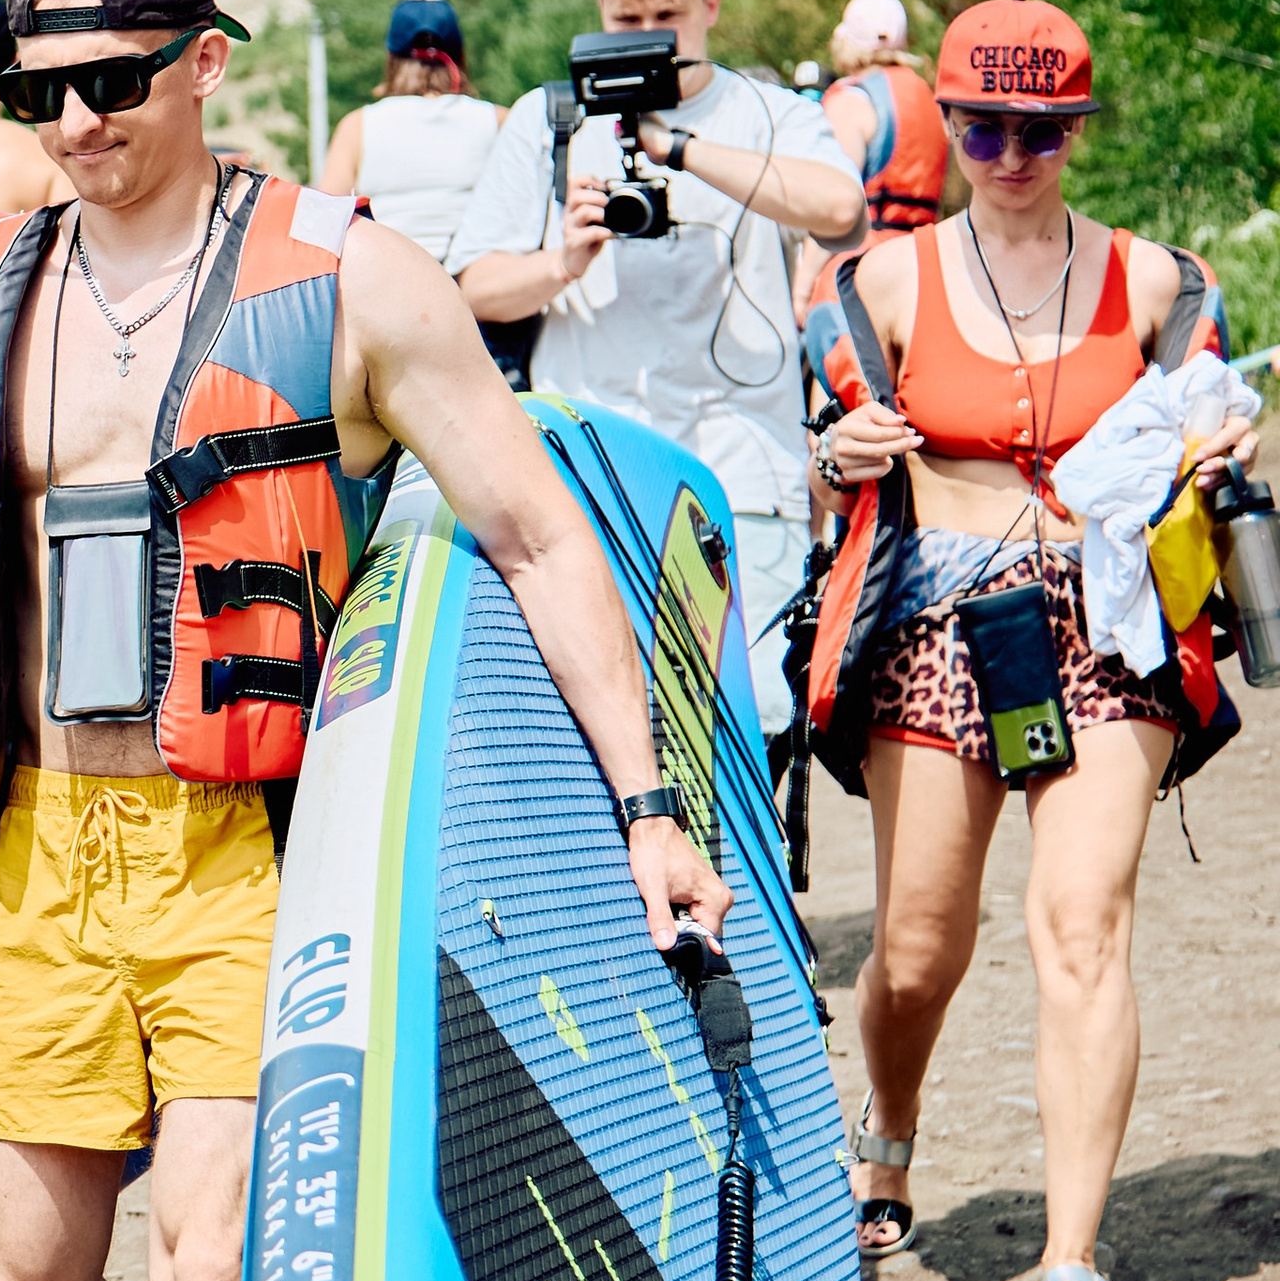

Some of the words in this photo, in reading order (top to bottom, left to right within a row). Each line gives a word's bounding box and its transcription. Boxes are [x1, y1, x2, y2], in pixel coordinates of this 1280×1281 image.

[971, 45, 1067, 72] CHICAGO
[981, 70, 1056, 95] BULLS
[327, 639, 388, 704] SUP
[276, 932, 352, 1041] FLIP
[267, 1120, 293, 1172] 341
[263, 1197, 288, 1239] 84
